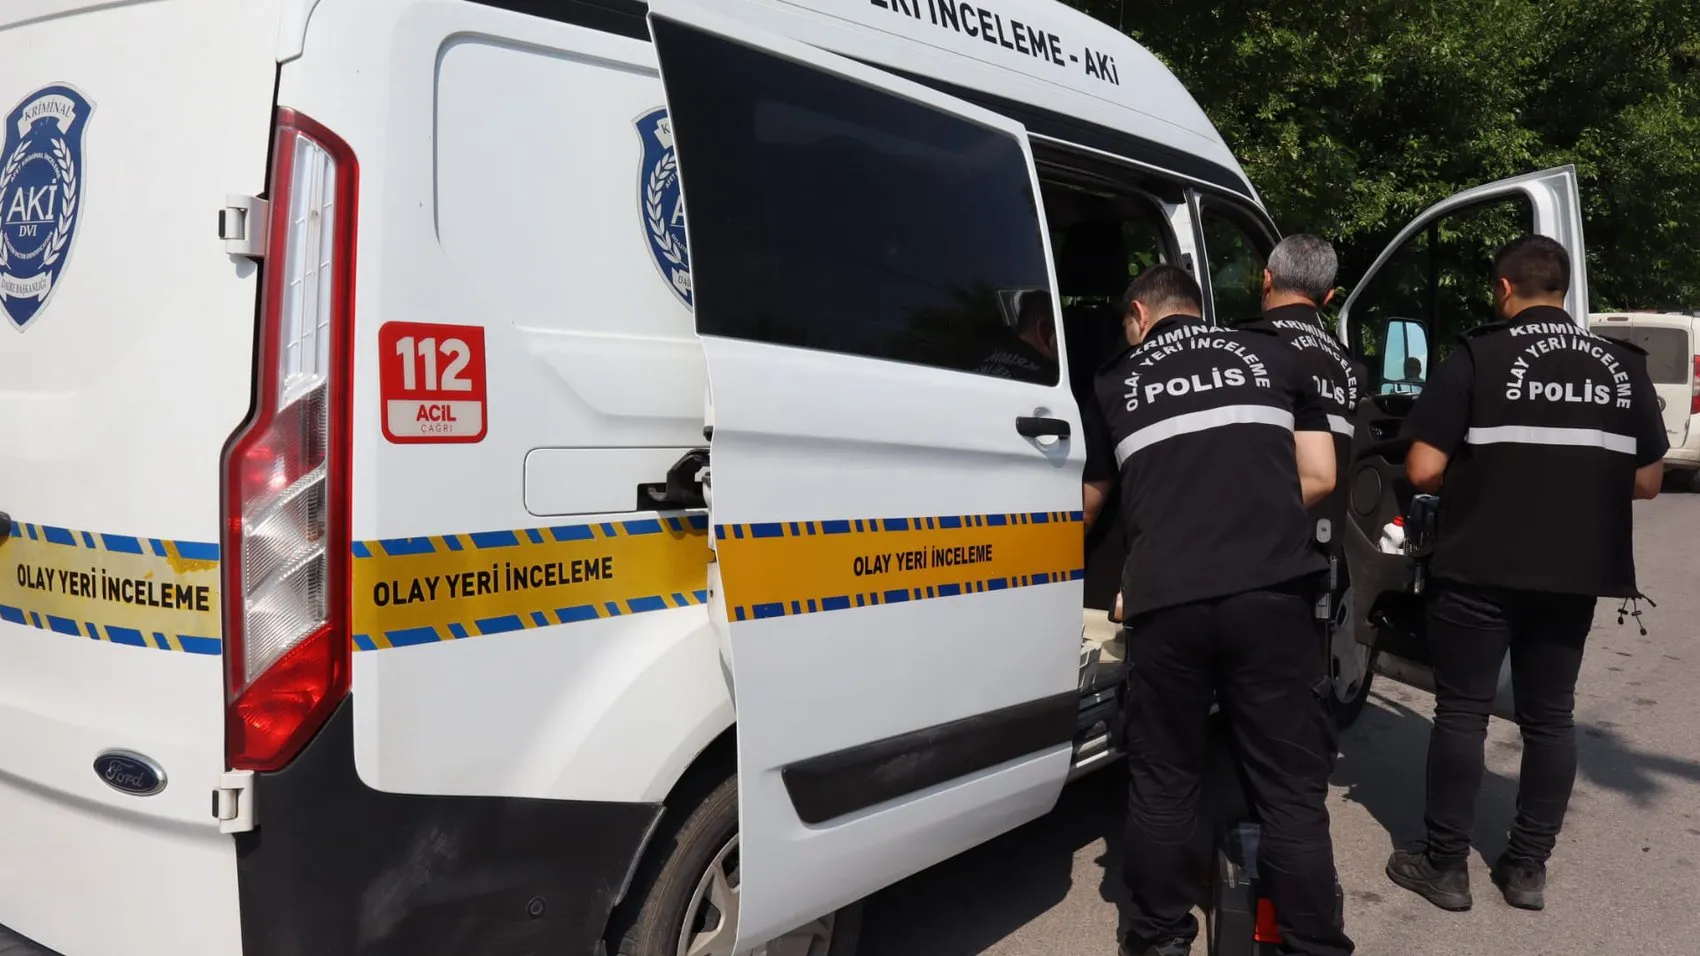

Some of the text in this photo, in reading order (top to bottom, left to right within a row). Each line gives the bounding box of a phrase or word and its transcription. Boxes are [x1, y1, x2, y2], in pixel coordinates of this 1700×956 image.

[6, 178, 57, 222] AKİ
[19, 224, 38, 237] DVI
[396, 336, 472, 392] 112
[1139, 341, 1184, 367] YERİ
[1190, 337, 1271, 388] İNCELEME
[1506, 334, 1632, 409] OLAY YERİ İNCELEME
[1144, 366, 1246, 404] POLİS
[1529, 378, 1610, 405] POLİS
[373, 556, 613, 607] OLAY YERİ İNCELEME
[853, 544, 992, 576] OLAY YERİ İNCELEME
[17, 563, 209, 611] OLAY YERİ İNCELEME
[105, 759, 145, 787] Ford
